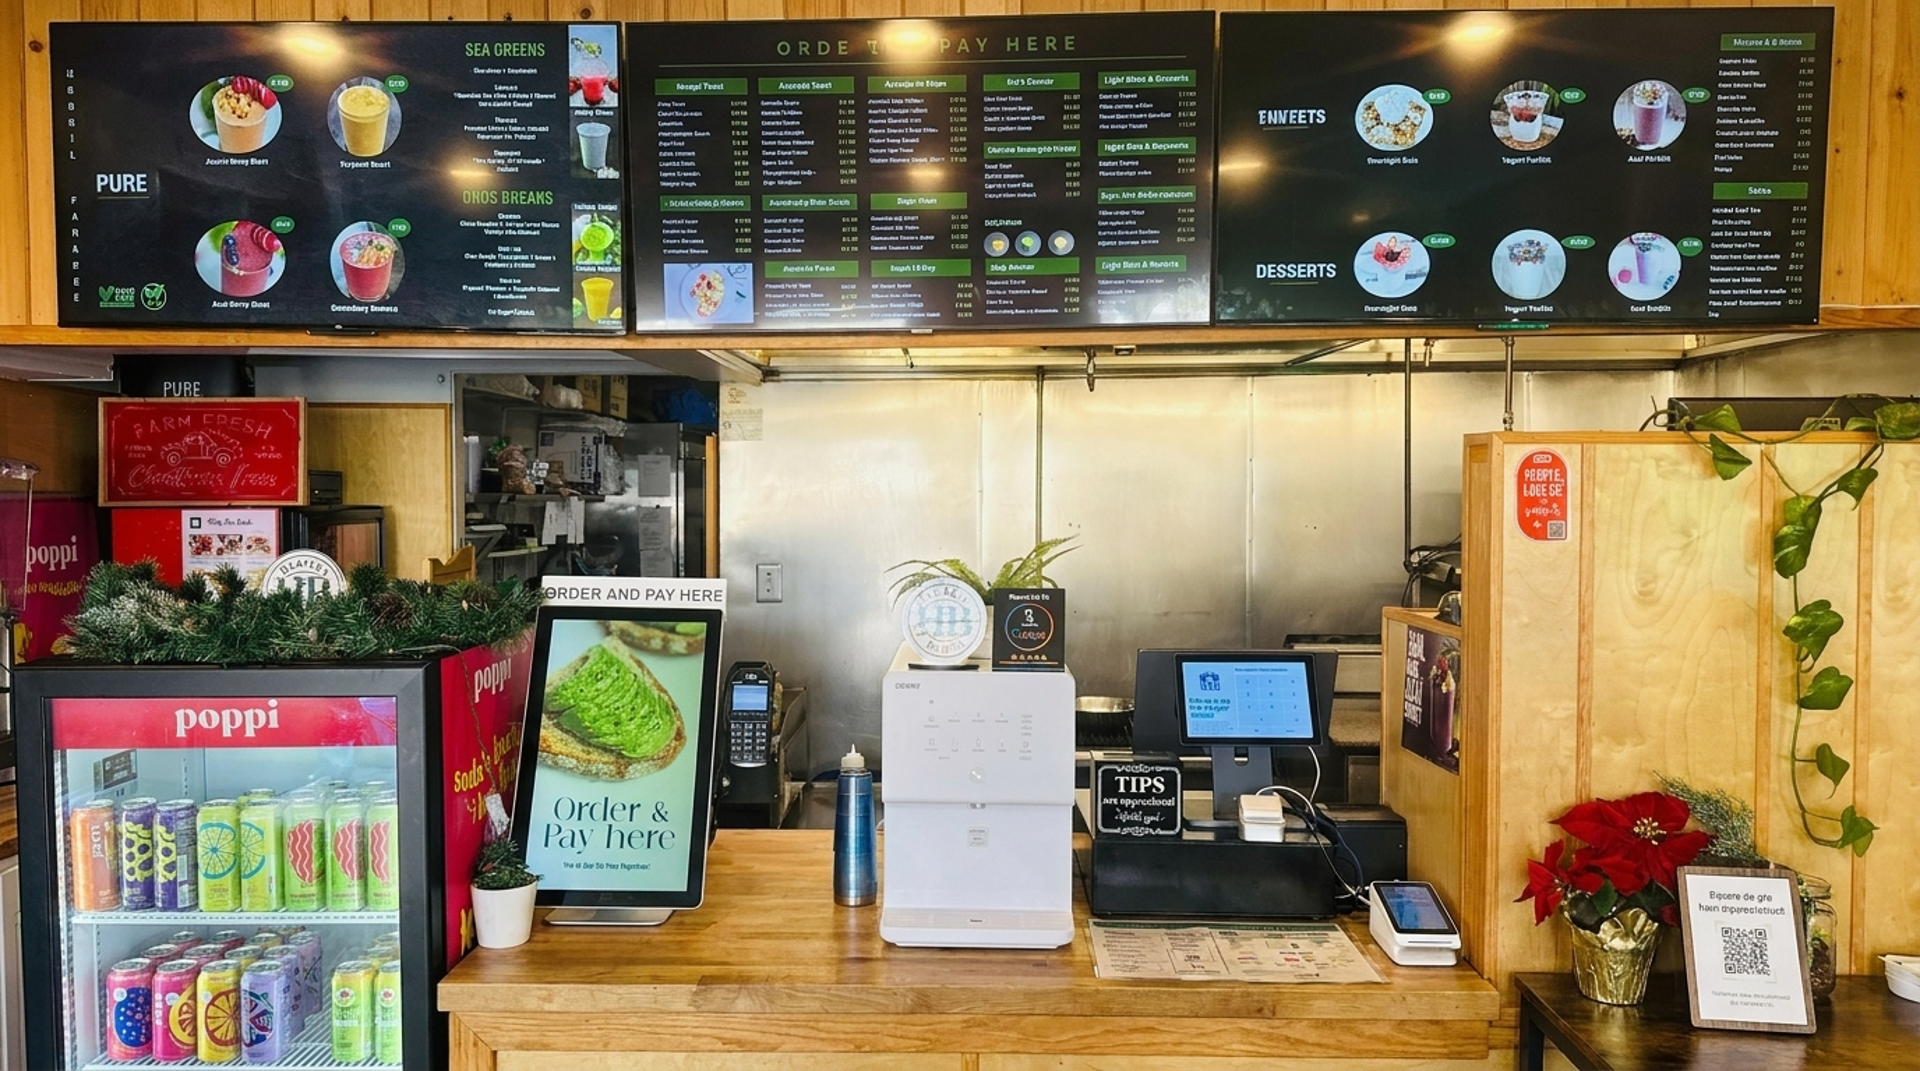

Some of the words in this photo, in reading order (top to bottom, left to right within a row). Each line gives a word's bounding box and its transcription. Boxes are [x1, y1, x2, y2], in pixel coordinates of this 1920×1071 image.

[465, 42, 491, 57] SEA
[493, 42, 546, 57] GREENS
[939, 37, 988, 53] PAY
[1006, 35, 1077, 52] HERE
[96, 173, 148, 193] PURE
[1256, 263, 1337, 279] DESSERTS
[26, 535, 79, 573] poppi
[545, 587, 602, 601] ORDER
[606, 588, 640, 601] AND
[645, 589, 675, 601] PAY
[680, 589, 723, 602] HERE
[174, 698, 280, 738] poppi
[1114, 776, 1166, 794] TIPS
[553, 796, 642, 823] Order
[651, 801, 669, 823] &
[543, 823, 594, 854] Pay
[606, 823, 676, 850] here
